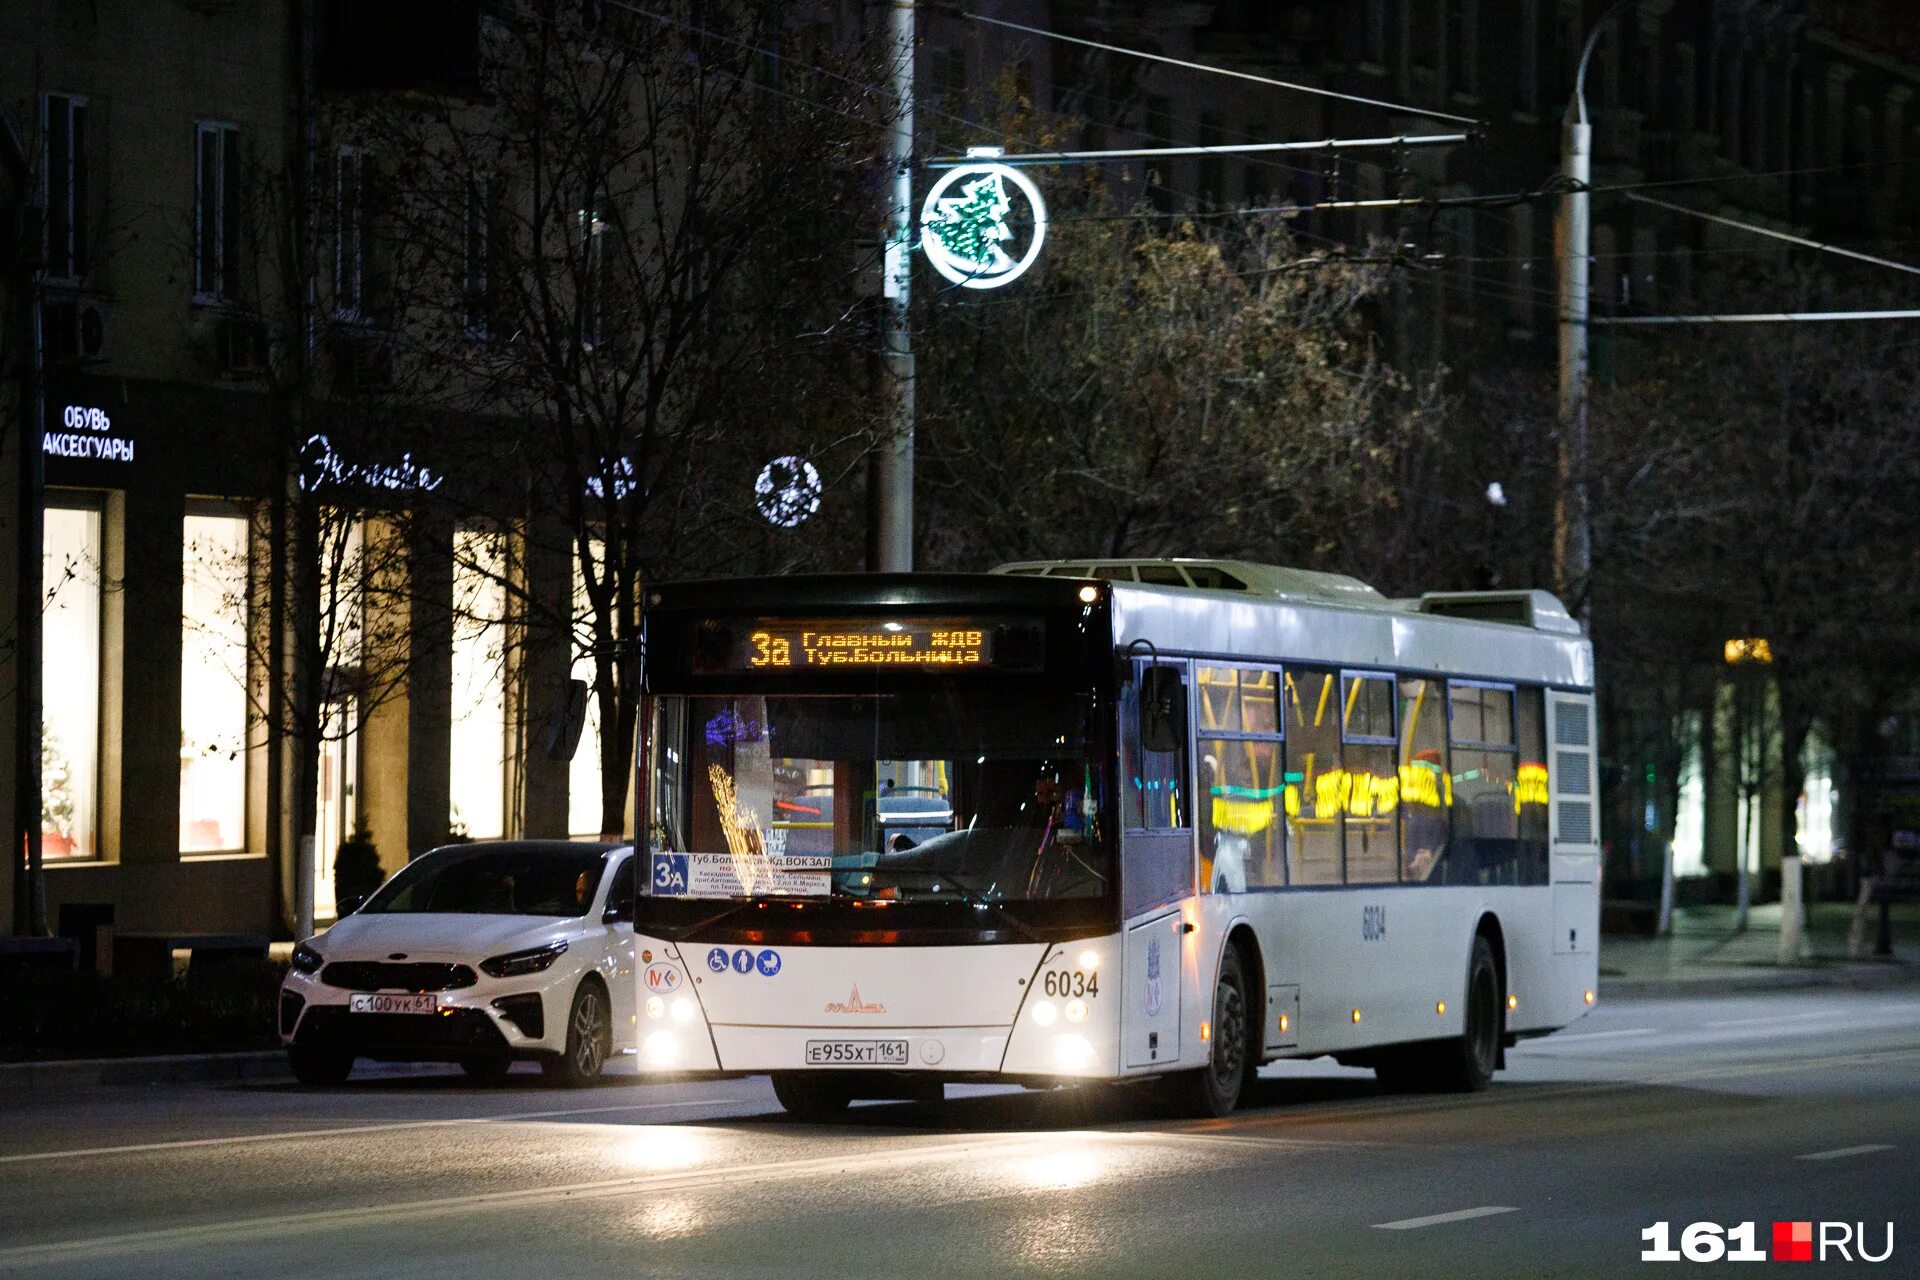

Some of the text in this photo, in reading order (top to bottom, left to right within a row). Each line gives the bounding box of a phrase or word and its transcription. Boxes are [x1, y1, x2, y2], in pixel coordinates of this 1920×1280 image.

[64, 405, 110, 431] ОБУВЬ
[43, 432, 134, 461] АКСЕССУАРЫ
[803, 631, 982, 648] Главный ЖДВ
[805, 648, 979, 665] Туб.Больница
[1363, 904, 1386, 941] 6034
[1044, 970, 1099, 998] 6034
